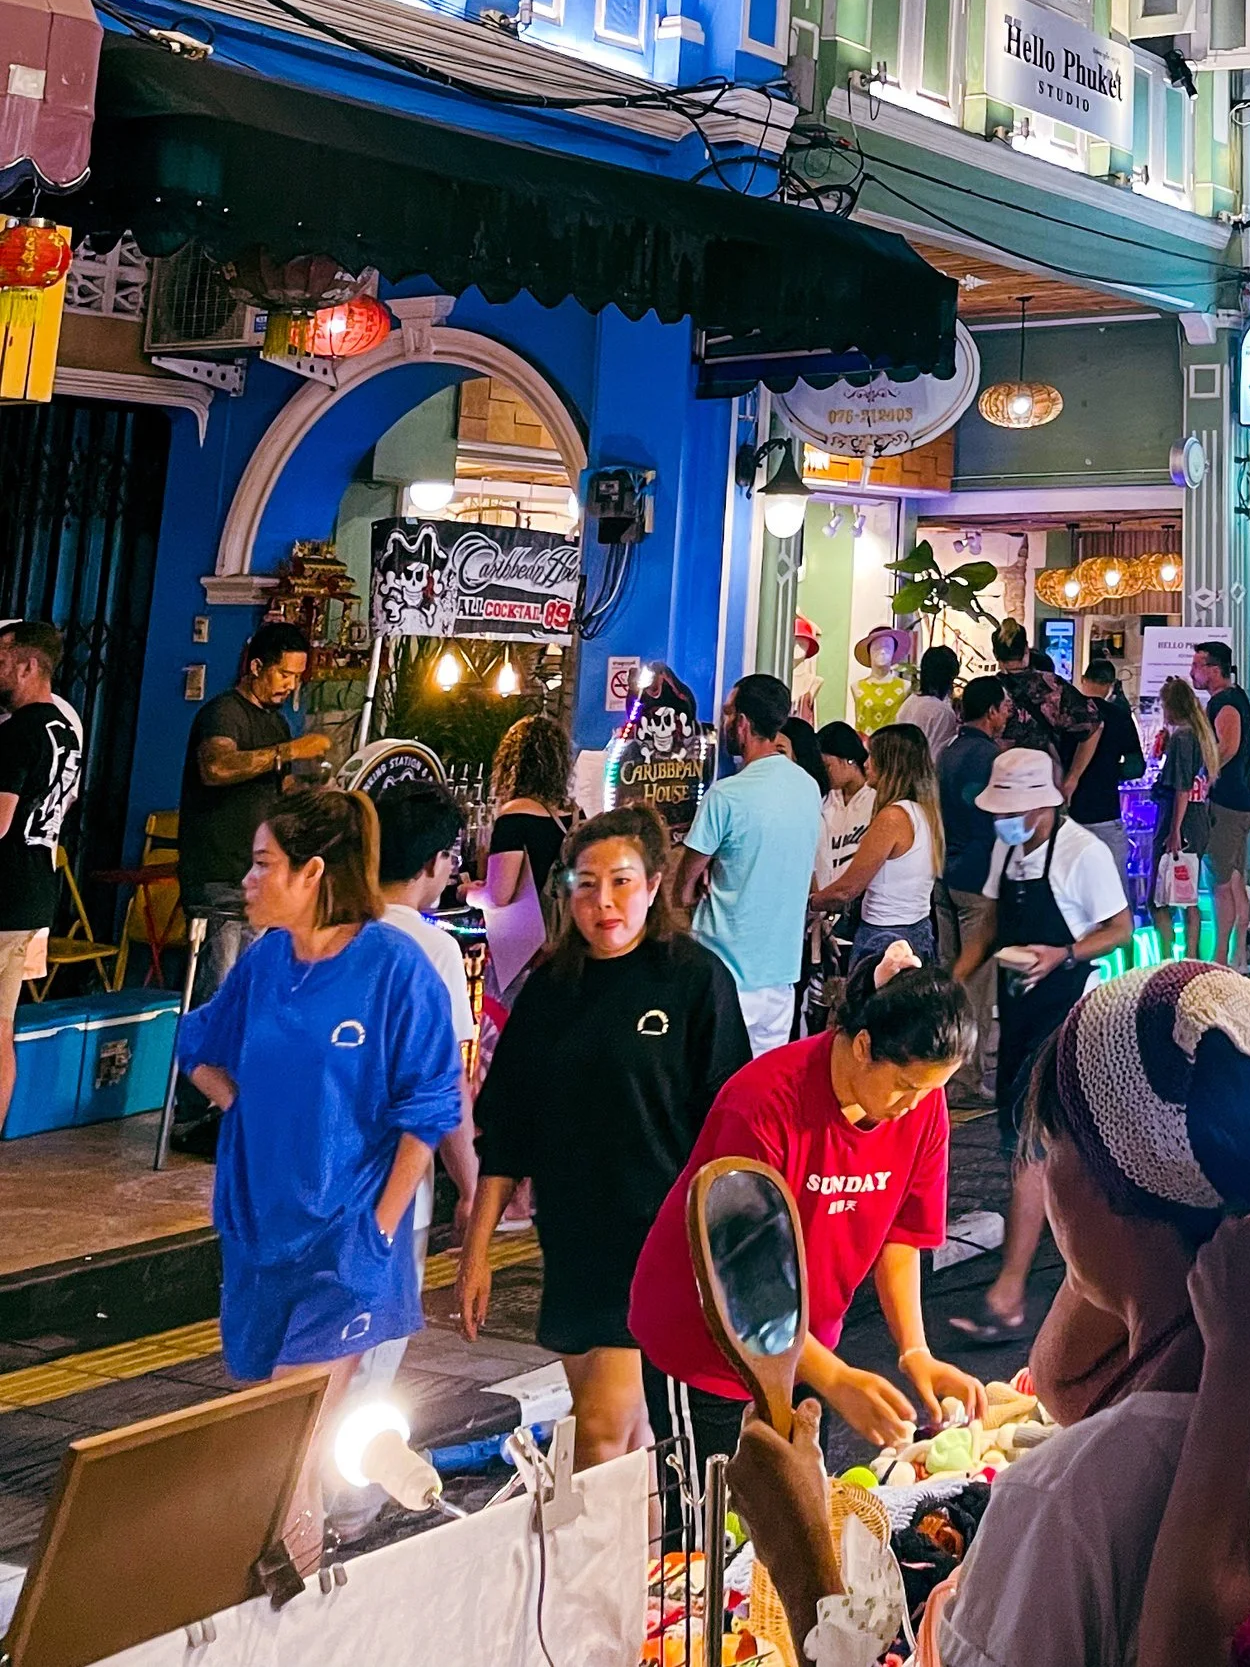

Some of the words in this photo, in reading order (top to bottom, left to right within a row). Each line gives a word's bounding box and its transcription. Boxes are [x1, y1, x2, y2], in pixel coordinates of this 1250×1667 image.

[1005, 22, 1056, 73] Hello
[1063, 48, 1123, 102] Phuket
[1038, 80, 1090, 113] STUDIO
[452, 534, 545, 594] Caribbean
[457, 598, 484, 618] ALL
[484, 601, 541, 621] COCKTAIL
[389, 755, 423, 772] STATION
[806, 1171, 892, 1195] SUNDAY
